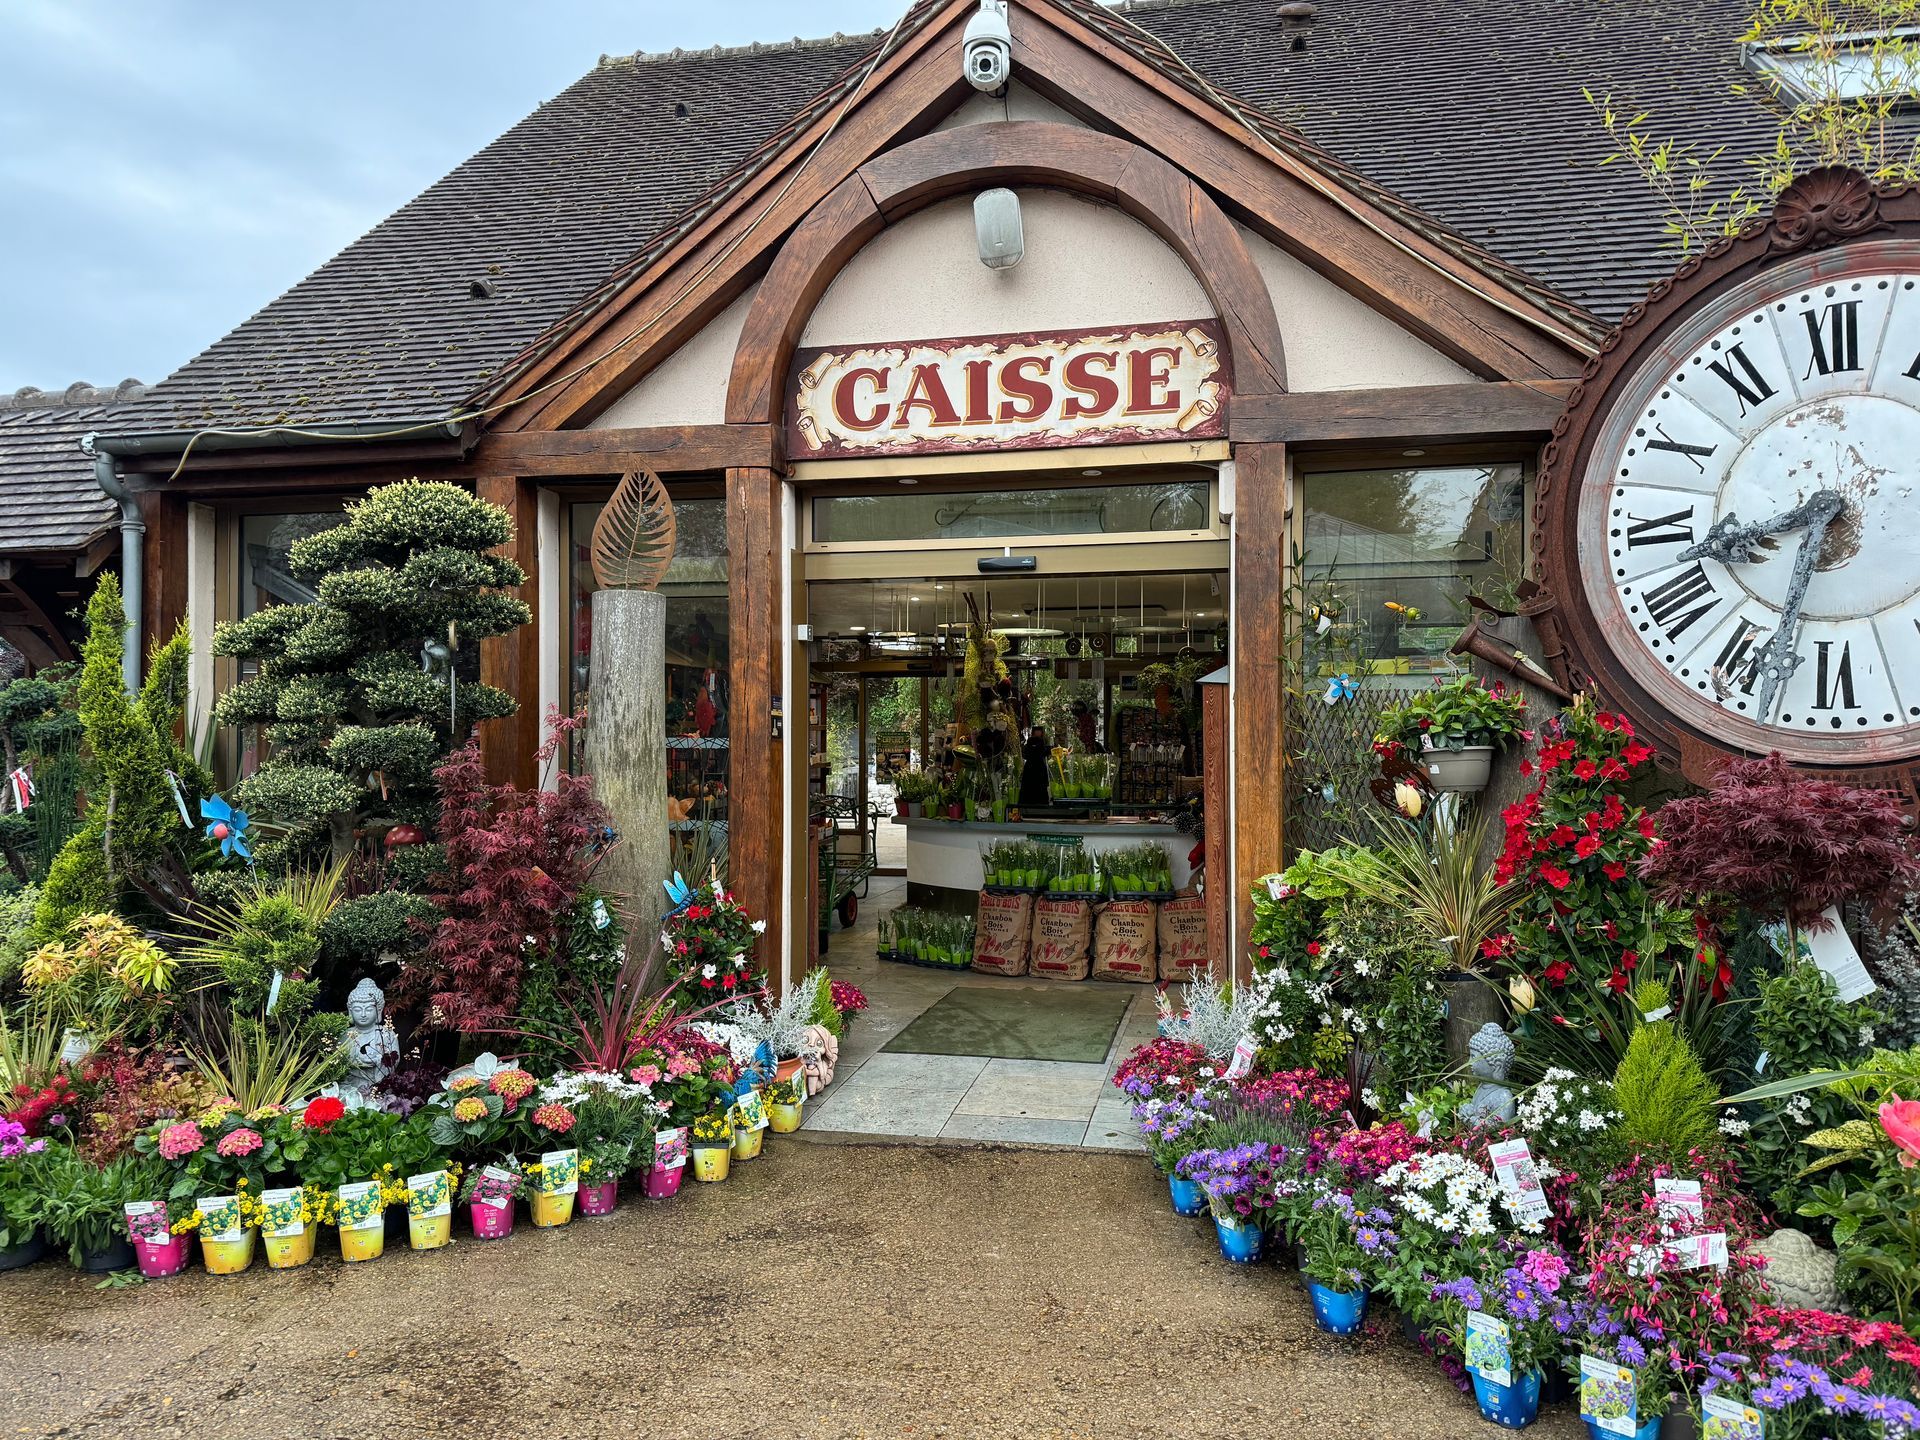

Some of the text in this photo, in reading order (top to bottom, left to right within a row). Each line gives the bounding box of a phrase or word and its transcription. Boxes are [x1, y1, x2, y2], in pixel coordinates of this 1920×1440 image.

[1799, 299, 1864, 381] XII
[833, 345, 1183, 431] CAISSE
[1704, 341, 1780, 419] XI
[1643, 422, 1719, 475] X
[1626, 504, 1695, 552] IX
[1641, 560, 1723, 645] VIII
[1810, 639, 1862, 710] VI
